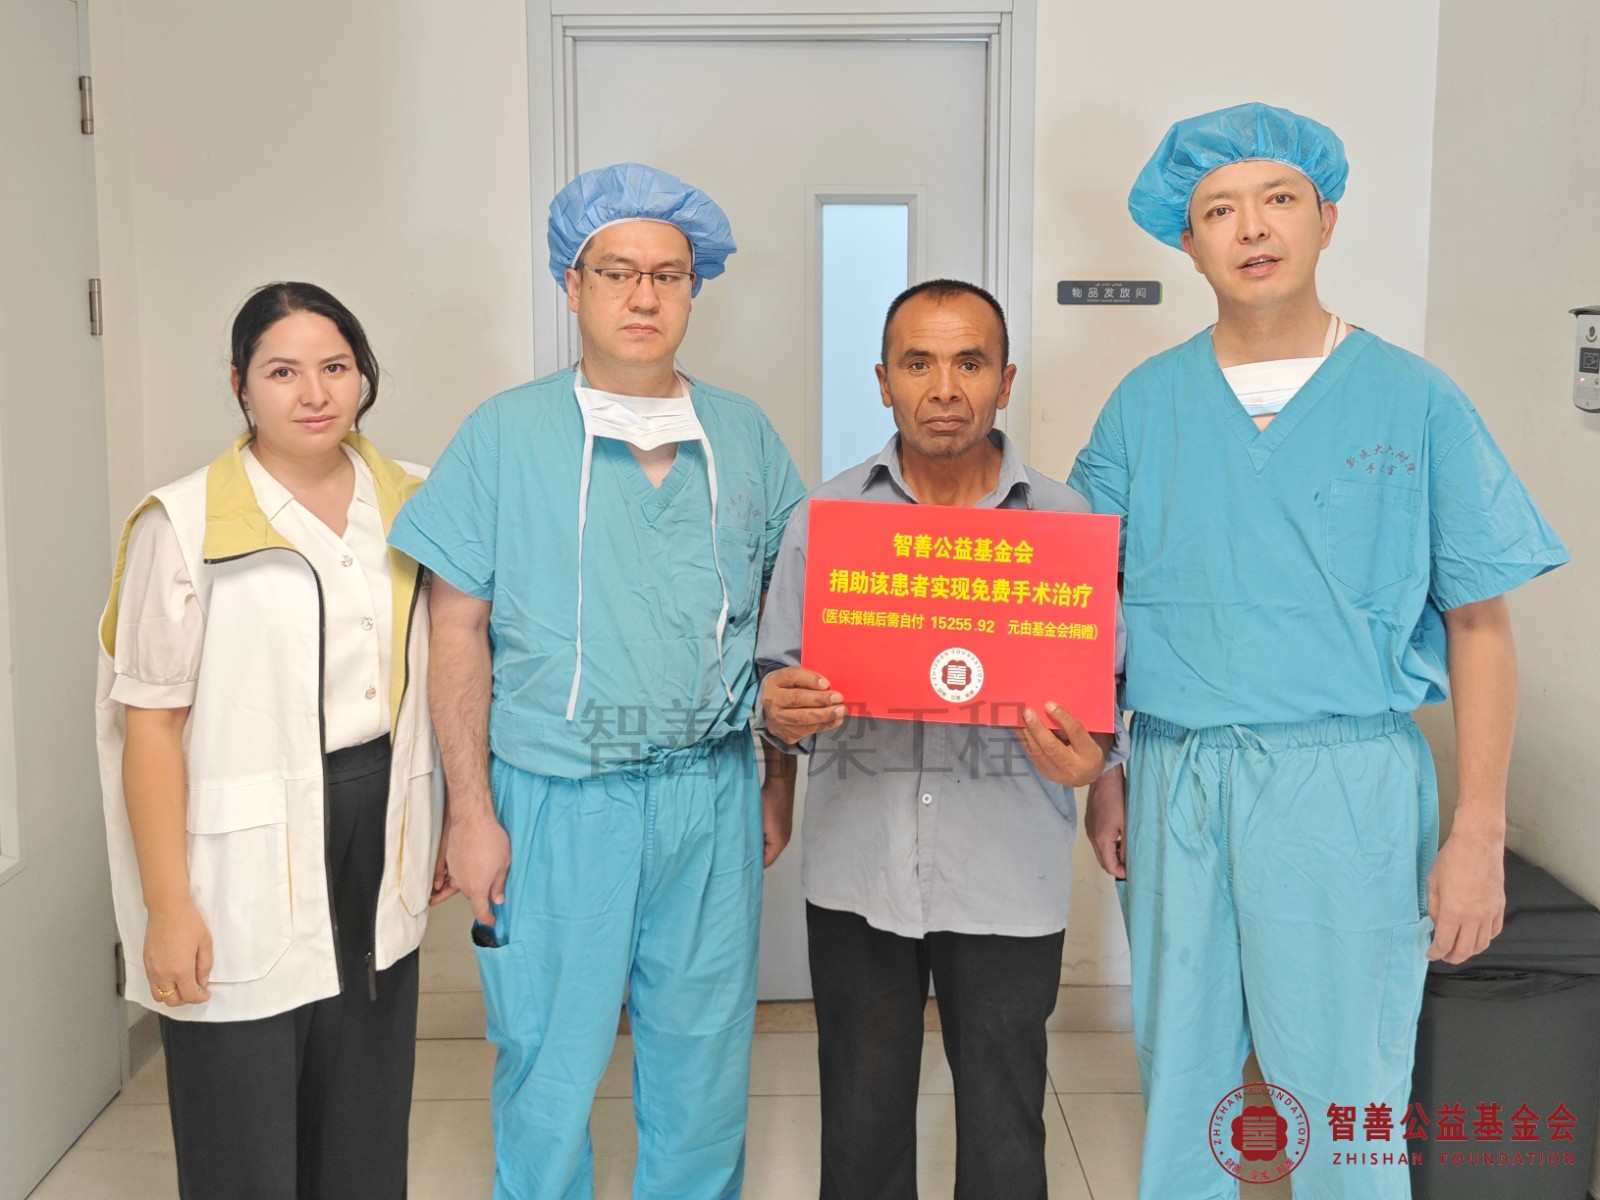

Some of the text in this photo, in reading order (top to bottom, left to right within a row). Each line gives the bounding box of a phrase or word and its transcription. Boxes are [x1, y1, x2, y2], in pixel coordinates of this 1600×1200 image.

[1071, 287, 1147, 299] 物品发放间
[893, 533, 1035, 565] 智善公益基金会
[829, 569, 1094, 609] 捐助该患者实现免费手术治疗
[931, 615, 996, 634] 15255.92
